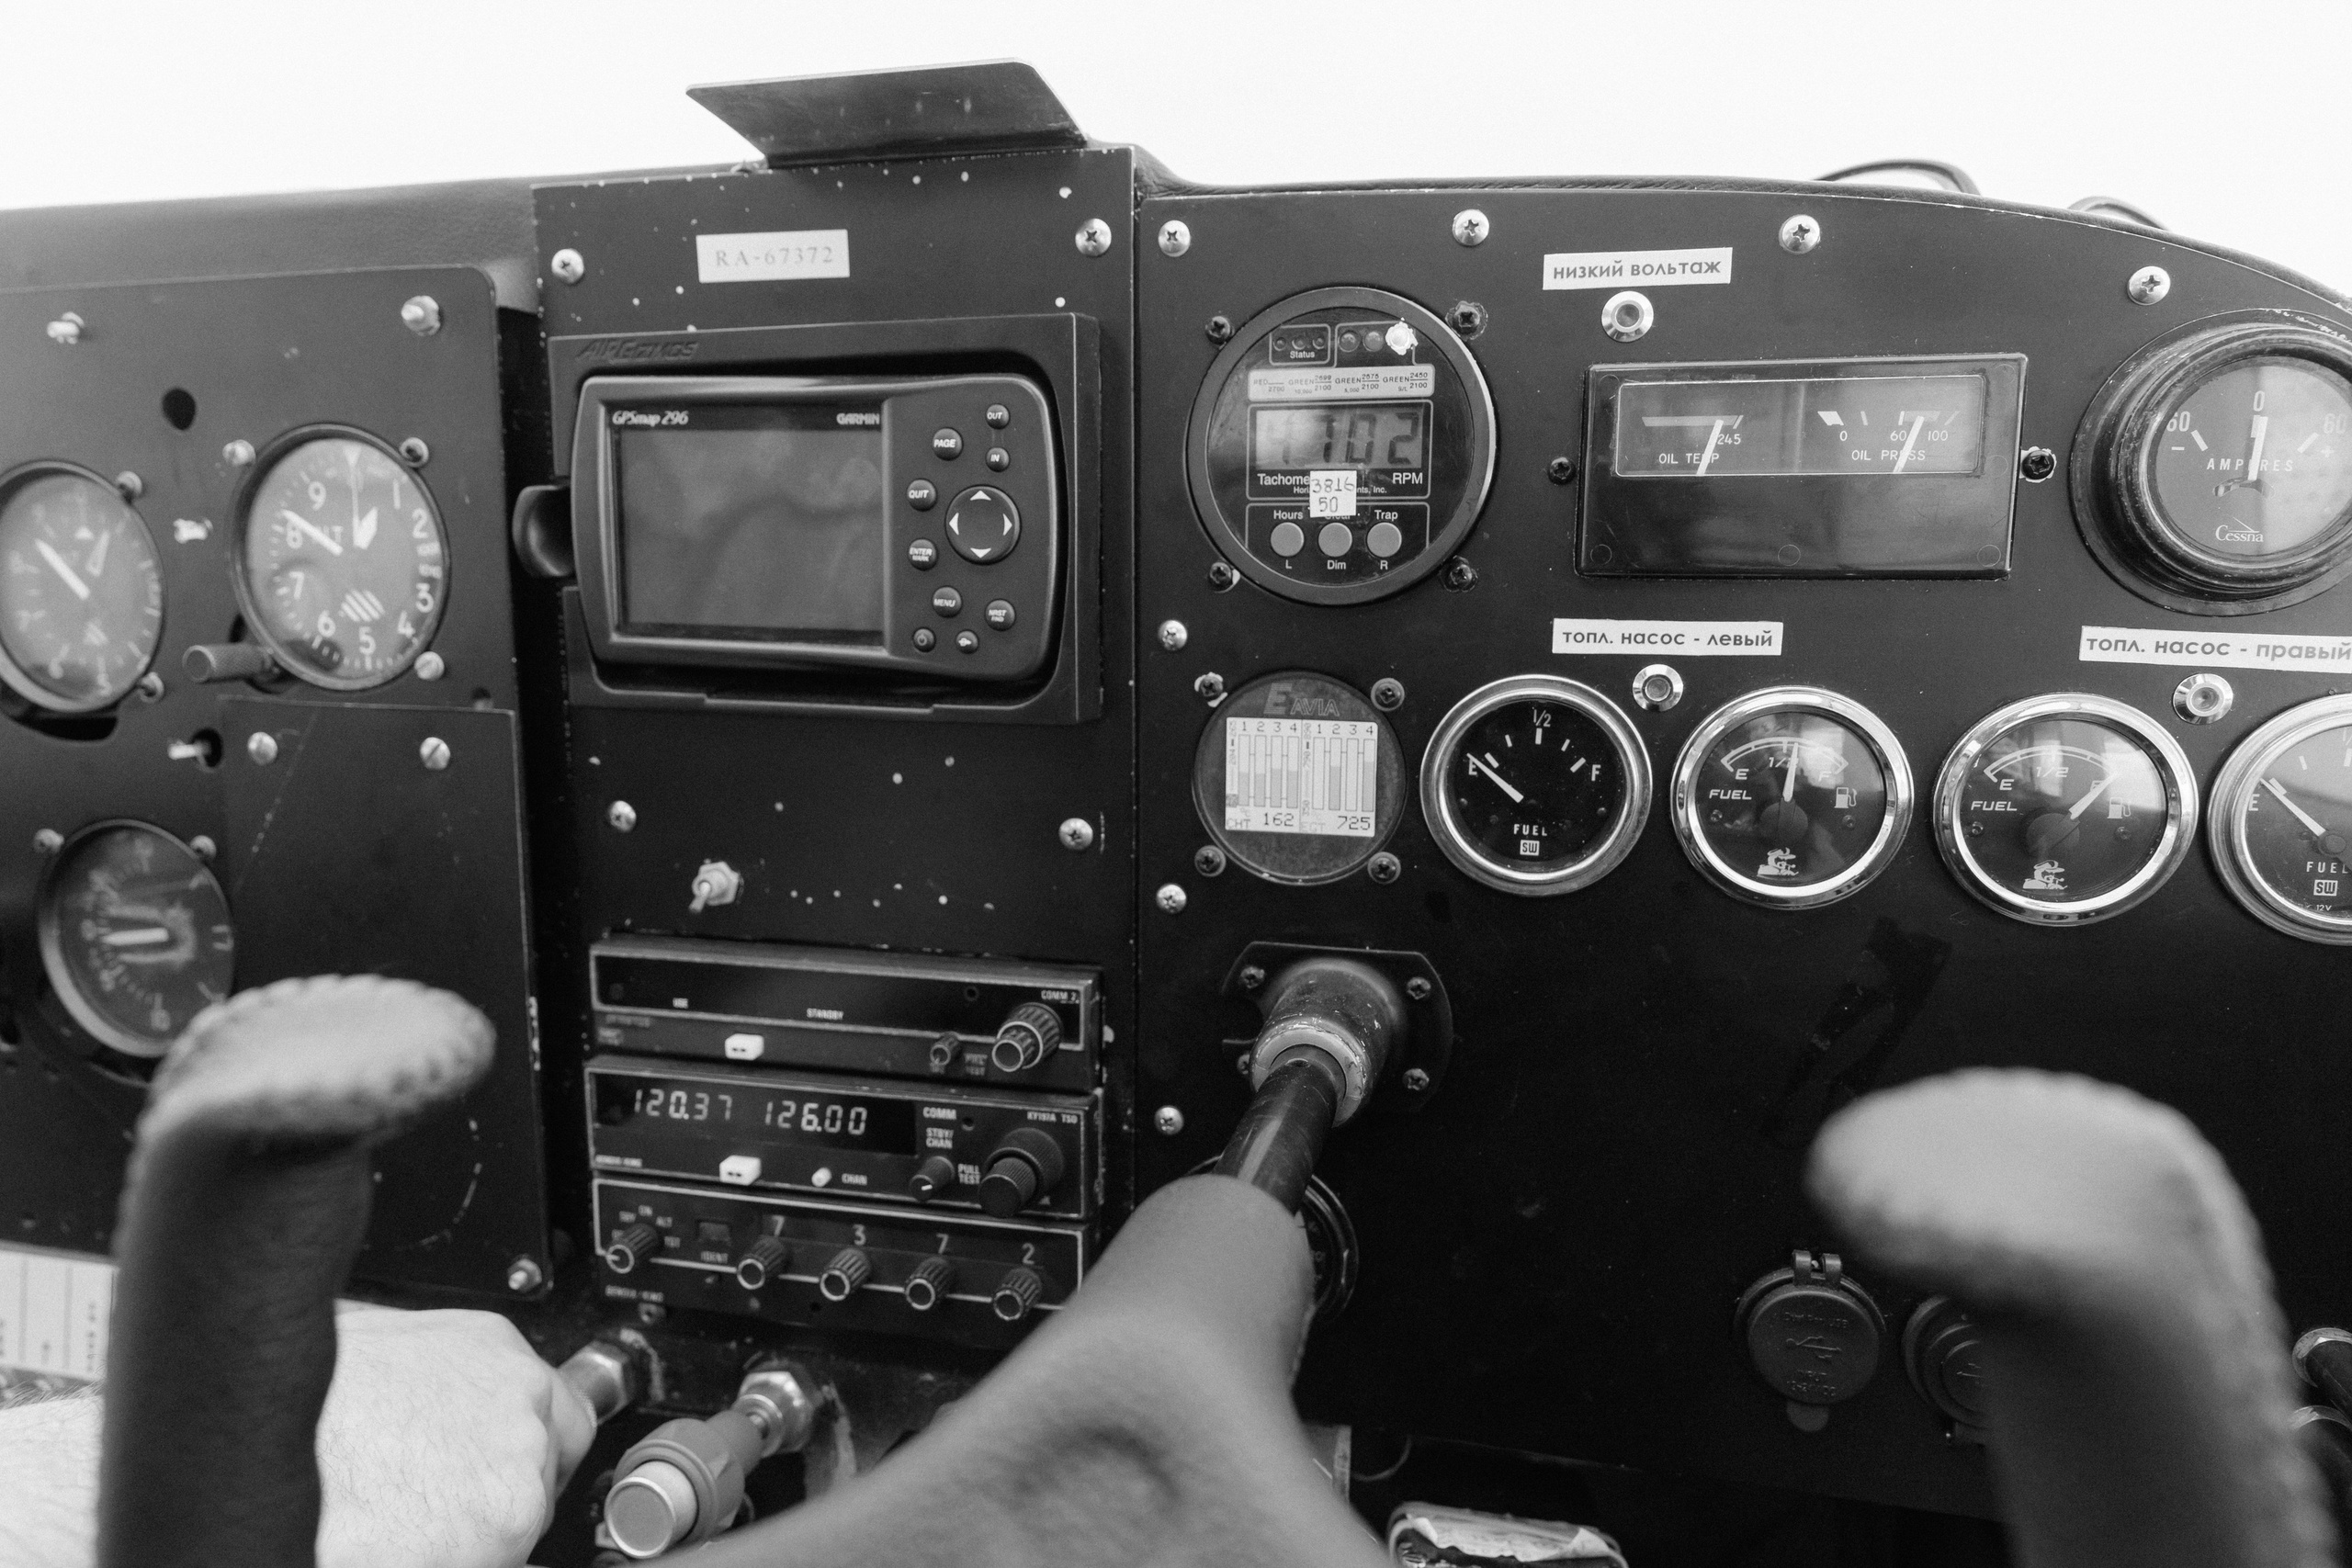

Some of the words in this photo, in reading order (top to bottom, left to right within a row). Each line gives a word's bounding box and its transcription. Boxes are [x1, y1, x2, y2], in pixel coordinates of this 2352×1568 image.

[716, 246, 832, 268] RA-67372
[1290, 350, 1316, 360] Status
[1288, 378, 1315, 386] GREEN
[2253, 390, 2265, 412] 0
[612, 410, 661, 427] GPSmap
[662, 410, 690, 425] 296
[836, 412, 880, 425] GARMIN
[987, 412, 1003, 421] OUT
[2166, 411, 2190, 432] 60
[2324, 413, 2348, 434] 60
[1717, 434, 1741, 445] 245
[1839, 430, 1848, 442] 0
[1890, 430, 1907, 442] 60
[1928, 430, 1949, 442] 100
[933, 438, 956, 448] PAGE
[990, 453, 1001, 462] IN
[1658, 453, 1679, 464] OIL
[1851, 449, 1871, 461] OIL
[1881, 449, 1926, 461] PRSS
[2206, 457, 2294, 472] AMPRES
[1257, 473, 1310, 485] Tachome
[1393, 473, 1423, 485] RPM
[1311, 477, 1355, 493] 3816
[308, 479, 327, 511] 9
[392, 479, 401, 510] 1
[909, 489, 930, 499] QUIT
[1318, 496, 1339, 513] 50
[1273, 510, 1304, 520] Hours
[1374, 510, 1398, 522] Trap
[413, 508, 429, 538] 2
[286, 519, 303, 549] 8
[2215, 525, 2264, 543] Cessna
[910, 547, 933, 556] ENTER
[1285, 559, 1292, 570] L
[1327, 559, 1347, 570] Dim
[1380, 560, 1388, 570] R
[288, 570, 305, 600] 7
[415, 582, 435, 613] 3
[933, 598, 956, 607] MENU
[317, 610, 336, 637] 6
[397, 610, 415, 638] 4
[358, 626, 377, 655] 5
[1532, 709, 1552, 728] 1/2
[1242, 721, 1247, 731] 1
[1257, 721, 1265, 732] 2
[1273, 722, 1282, 732] 3
[1290, 723, 1297, 733] 4
[1317, 724, 1322, 734] 1
[1332, 724, 1340, 735] 2
[1349, 724, 1357, 735] 3
[1366, 725, 1374, 735] 4
[1591, 764, 1600, 782] F
[1735, 768, 1749, 780] E
[1818, 771, 1832, 782] F
[2036, 766, 2069, 778] 1/2
[1999, 779, 2015, 791] E
[1709, 789, 1752, 801] FUEL
[1971, 800, 2018, 811] FUEL
[2248, 794, 2260, 811] E
[1263, 812, 1295, 827] 162
[1338, 816, 1371, 830] 725
[1513, 824, 1548, 837] FUEL
[1521, 840, 1539, 855] SW
[2306, 861, 2348, 874] FUEL
[2315, 881, 2336, 895] SW
[2316, 904, 2332, 912] 12V
[1041, 989, 1069, 1000] COMM
[634, 1089, 732, 1122] 120.37
[764, 1100, 867, 1135] 126.00
[922, 1107, 957, 1121] COMM
[1061, 1113, 1078, 1124] TSO
[925, 1137, 953, 1149] CHAN
[957, 1163, 979, 1174] PULL
[958, 1173, 980, 1185] TEST
[771, 1215, 785, 1236] 7
[853, 1224, 866, 1246] 3
[936, 1233, 950, 1254] 7
[1022, 1243, 1035, 1265] 2
